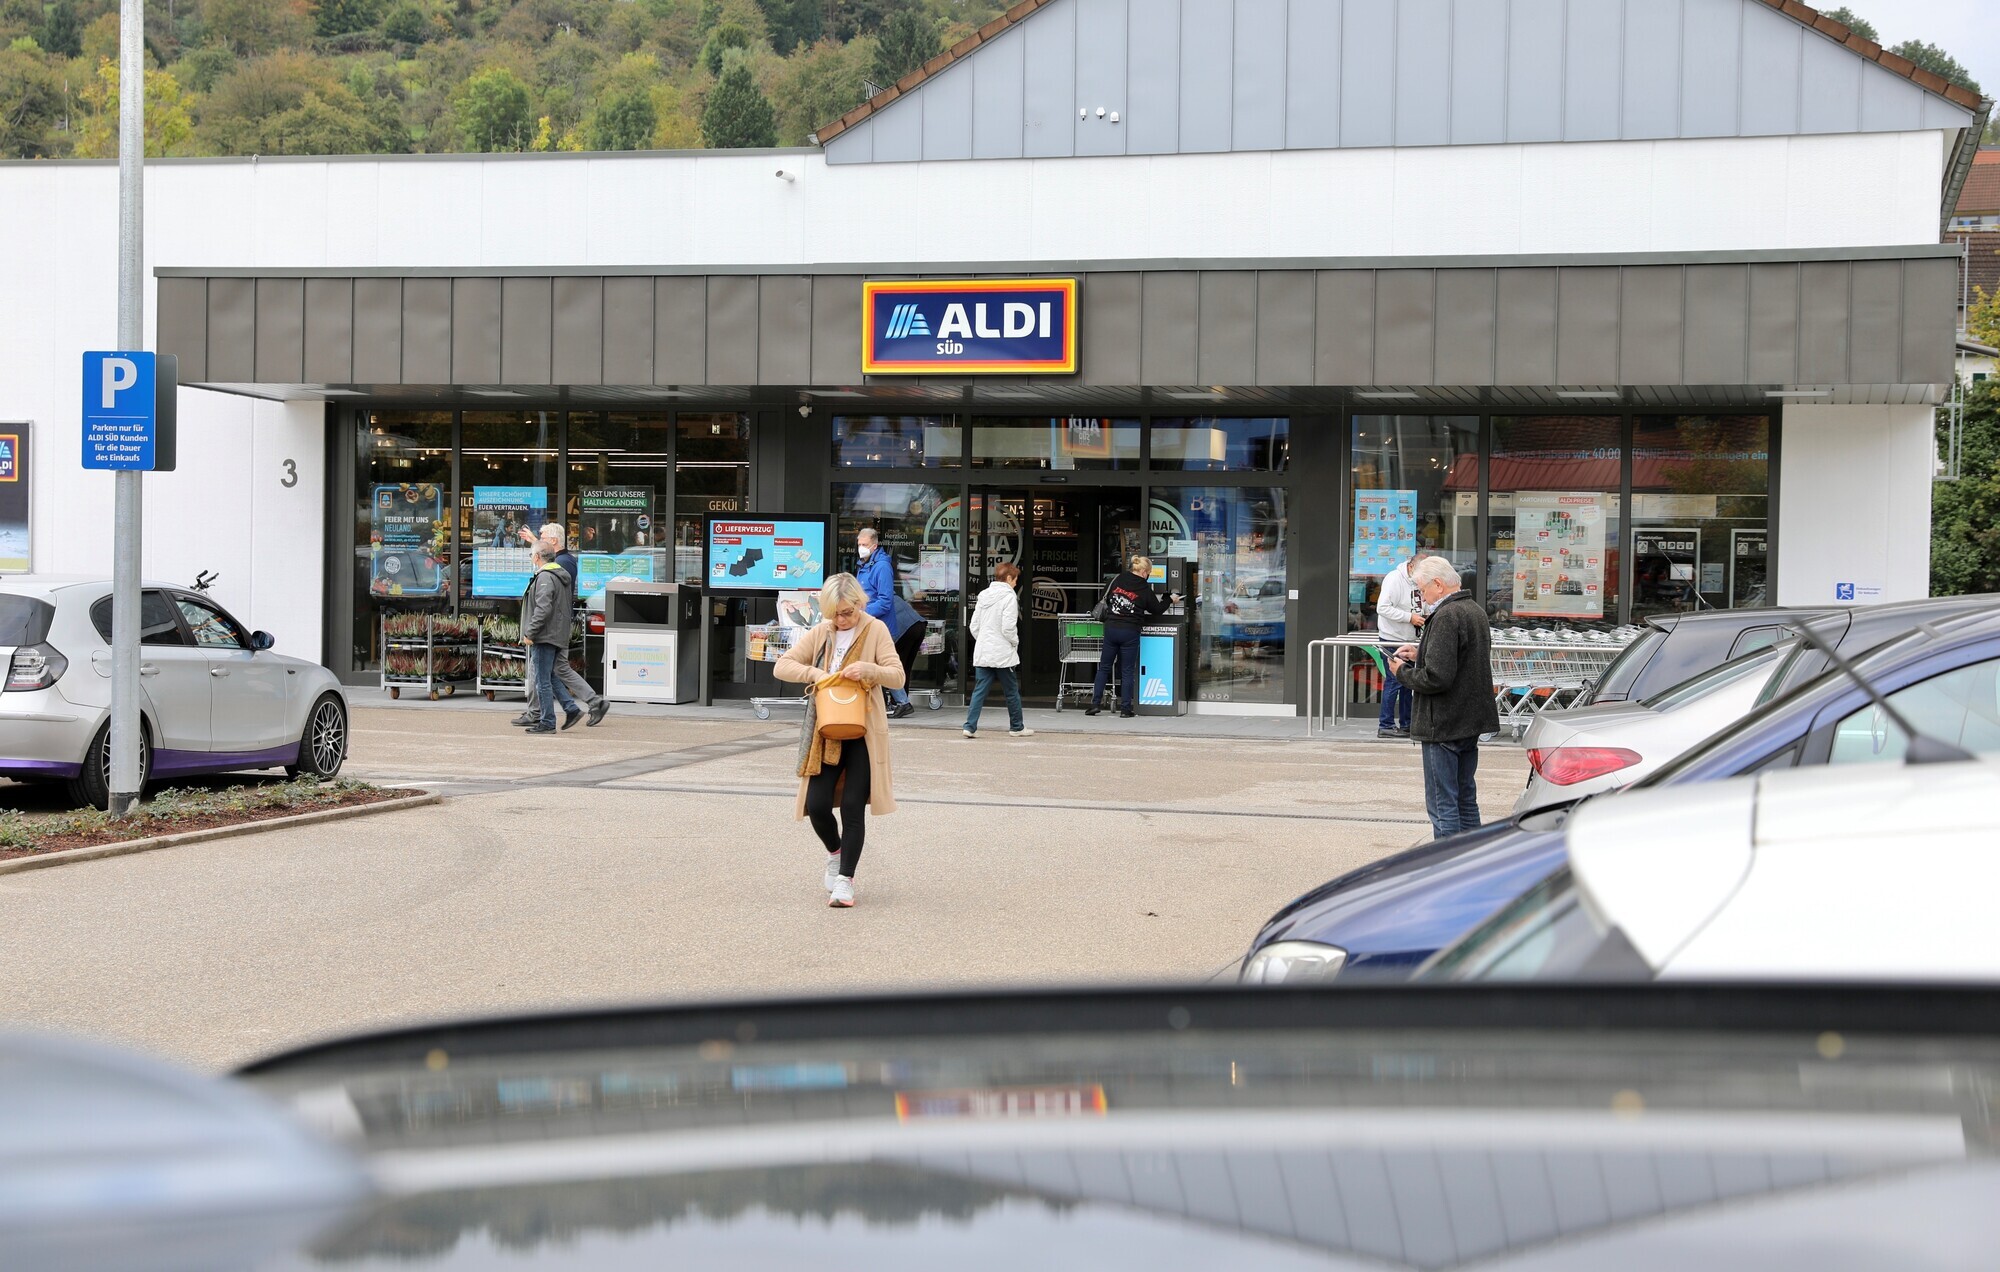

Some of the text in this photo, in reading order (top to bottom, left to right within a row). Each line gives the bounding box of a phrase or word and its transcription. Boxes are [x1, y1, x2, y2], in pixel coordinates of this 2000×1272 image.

[936, 302, 1051, 339] ALDI
[936, 339, 964, 355] SÜD
[101, 357, 138, 409] P
[92, 424, 118, 432] Parken
[133, 424, 144, 432] für
[87, 432, 149, 442] ALDI SÜD Kunden
[94, 444, 106, 452] für
[106, 444, 118, 452] die
[109, 454, 140, 462] Einkaufs
[1573, 450, 1590, 459] wir
[1592, 448, 1621, 460] 40.00
[1751, 450, 1768, 460] ein
[280, 458, 298, 488] 3
[616, 498, 646, 506] ÄNDERN.
[384, 524, 413, 532] NEULAND.
[1036, 564, 1064, 572] Gemüse
